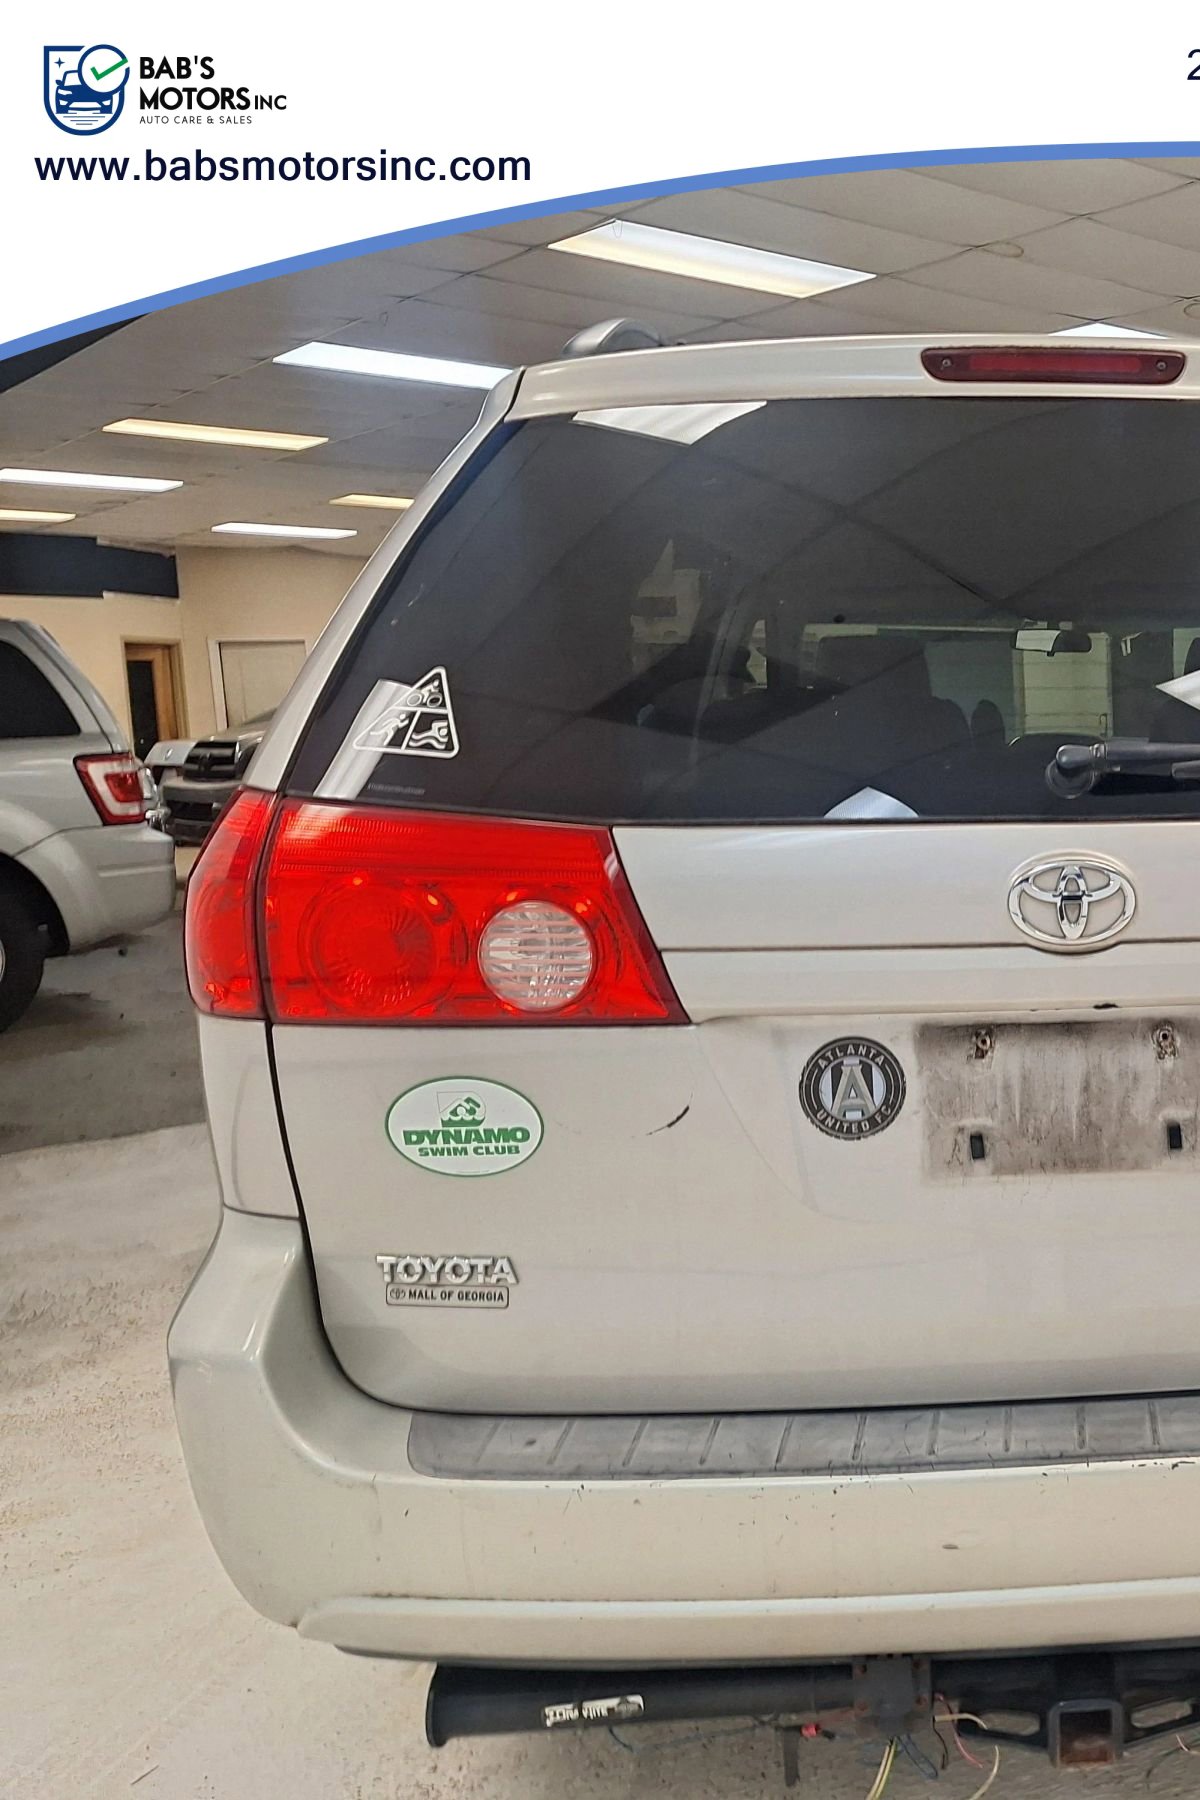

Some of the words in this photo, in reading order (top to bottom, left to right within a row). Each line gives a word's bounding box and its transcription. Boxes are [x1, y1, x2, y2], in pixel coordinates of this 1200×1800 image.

[818, 1043, 886, 1070] ATLANTA
[816, 1108, 870, 1134] UNITED
[873, 1104, 892, 1124] FC
[402, 1126, 531, 1146] DYNAMO
[418, 1146, 469, 1158] SWIM
[472, 1144, 521, 1156] CLUB
[375, 1254, 520, 1285] TOYOTA
[408, 1288, 438, 1301] MALL
[440, 1290, 454, 1301] OF
[457, 1290, 505, 1303] GEORGIA
